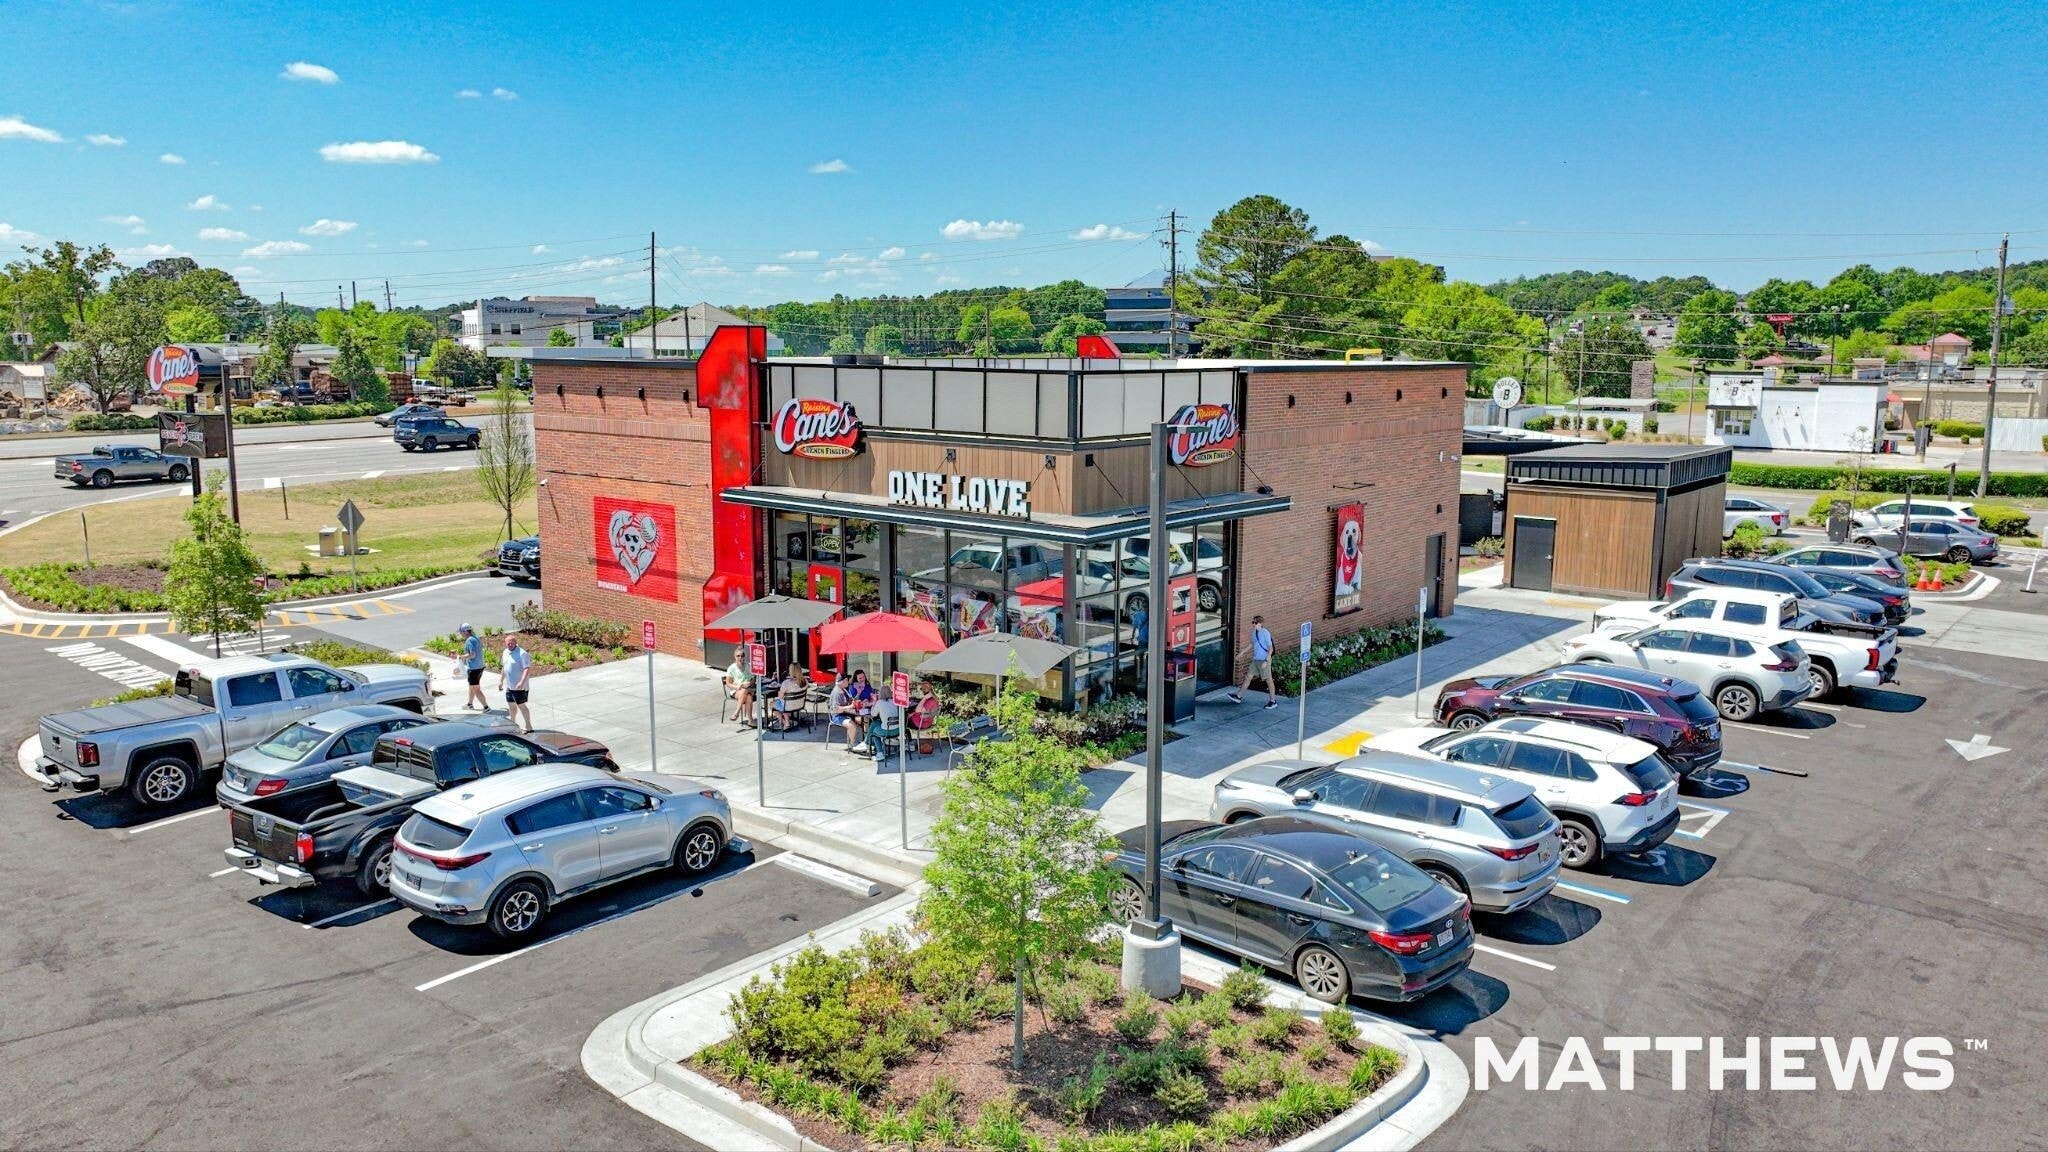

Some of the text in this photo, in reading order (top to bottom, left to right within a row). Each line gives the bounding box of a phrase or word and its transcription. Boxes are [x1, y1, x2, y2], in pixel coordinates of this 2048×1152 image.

[149, 346, 198, 391] Cane's
[1503, 389, 1511, 400] B
[802, 402, 831, 414] Raising
[1196, 407, 1221, 419] Raising
[774, 398, 860, 453] Cane's
[888, 470, 1029, 517] ONE LOVE
[43, 641, 106, 658] DO
[67, 650, 141, 672] NOT
